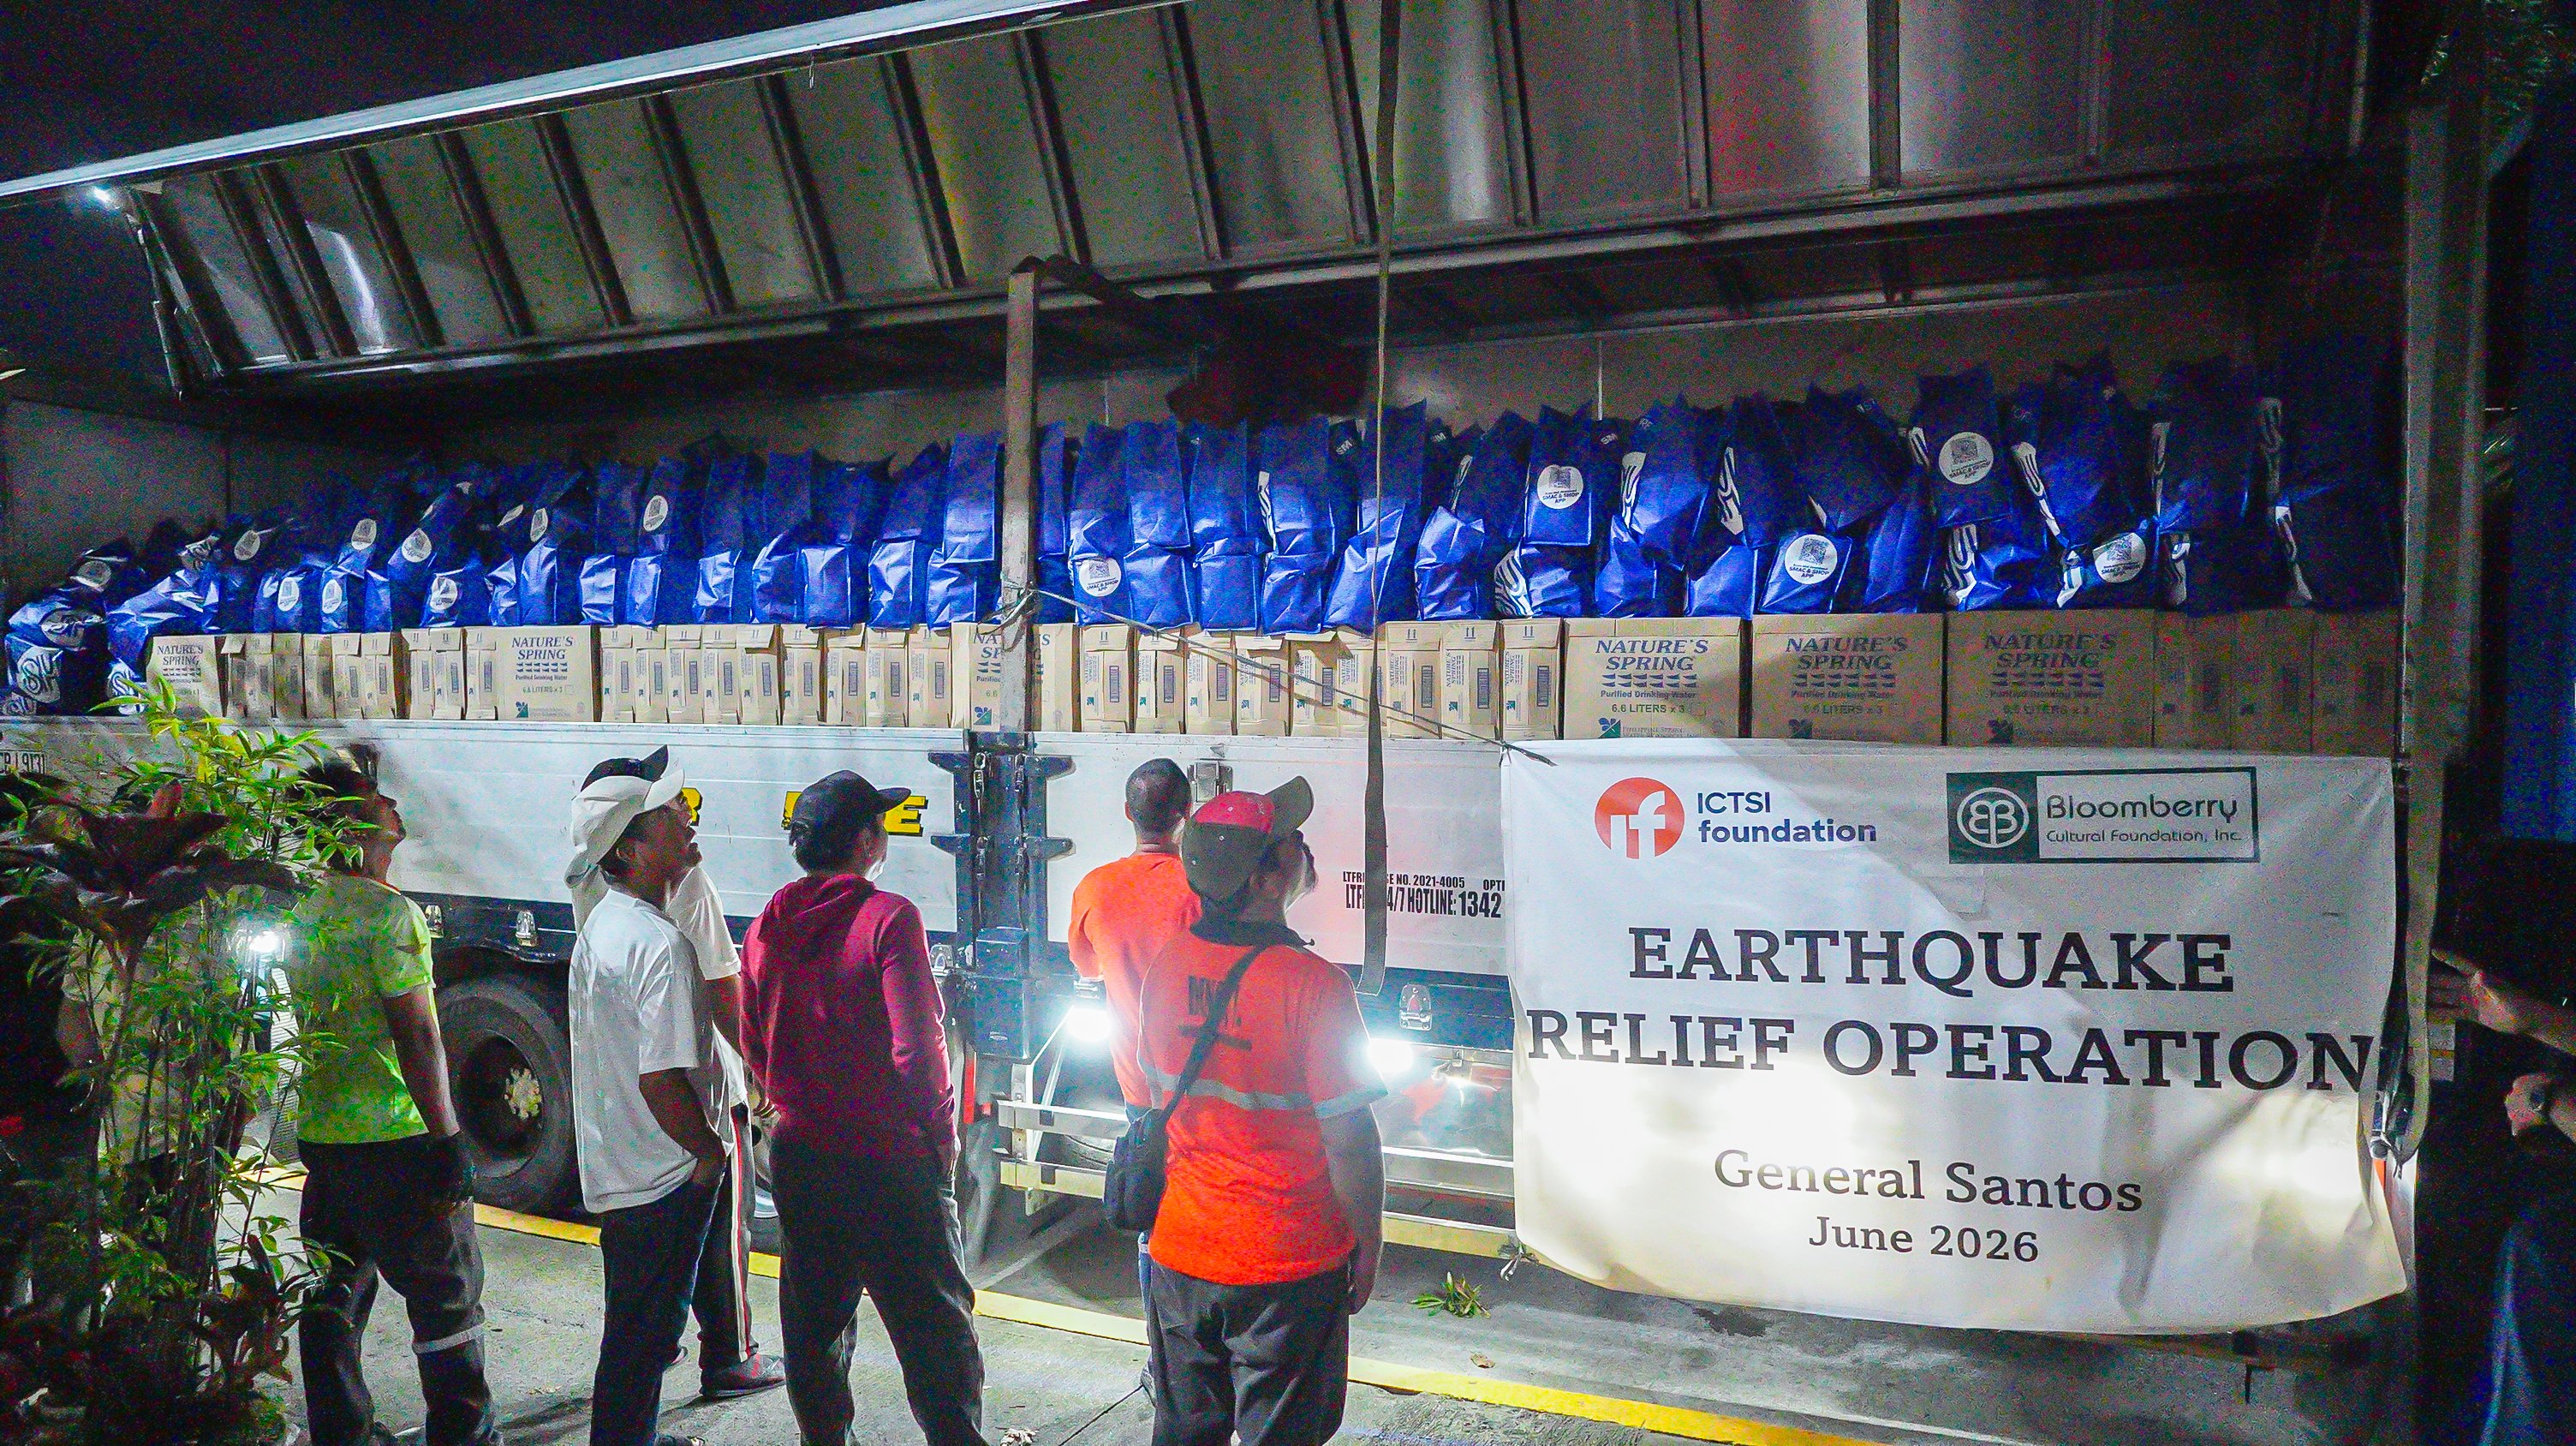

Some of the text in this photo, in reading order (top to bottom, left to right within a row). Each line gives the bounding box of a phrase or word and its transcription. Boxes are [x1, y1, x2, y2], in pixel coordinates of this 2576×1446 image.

[512, 636, 573, 648] NATURE'S
[1595, 639, 1708, 654] NATURE'S
[1786, 636, 1908, 652] NATURE'S
[518, 649, 566, 660] SPRING
[1797, 654, 1893, 670] SPRING
[1606, 656, 1695, 671] SPRING
[1635, 690, 1669, 700] Drinking
[1612, 704, 1627, 714] 6.6
[1630, 704, 1667, 714] LITERS
[1679, 704, 1685, 713] 3
[1697, 792, 1771, 814] ICTSI
[2047, 793, 2239, 824] Bloomberry
[1698, 818, 1877, 843] foundation
[2046, 829, 2242, 843] Cultural Foundation, Inc.
[1396, 874, 1412, 886] NO.
[1413, 875, 1465, 889] 2021-4005
[1407, 887, 1458, 916] HOTLINE:
[1458, 891, 1503, 918] 1342
[1629, 926, 2235, 997] EARTHQUAKE
[1528, 1009, 2374, 1095] RELIEF OPERATION
[1714, 1149, 2144, 1213] General Santos
[1809, 1215, 2040, 1263] June 2026
